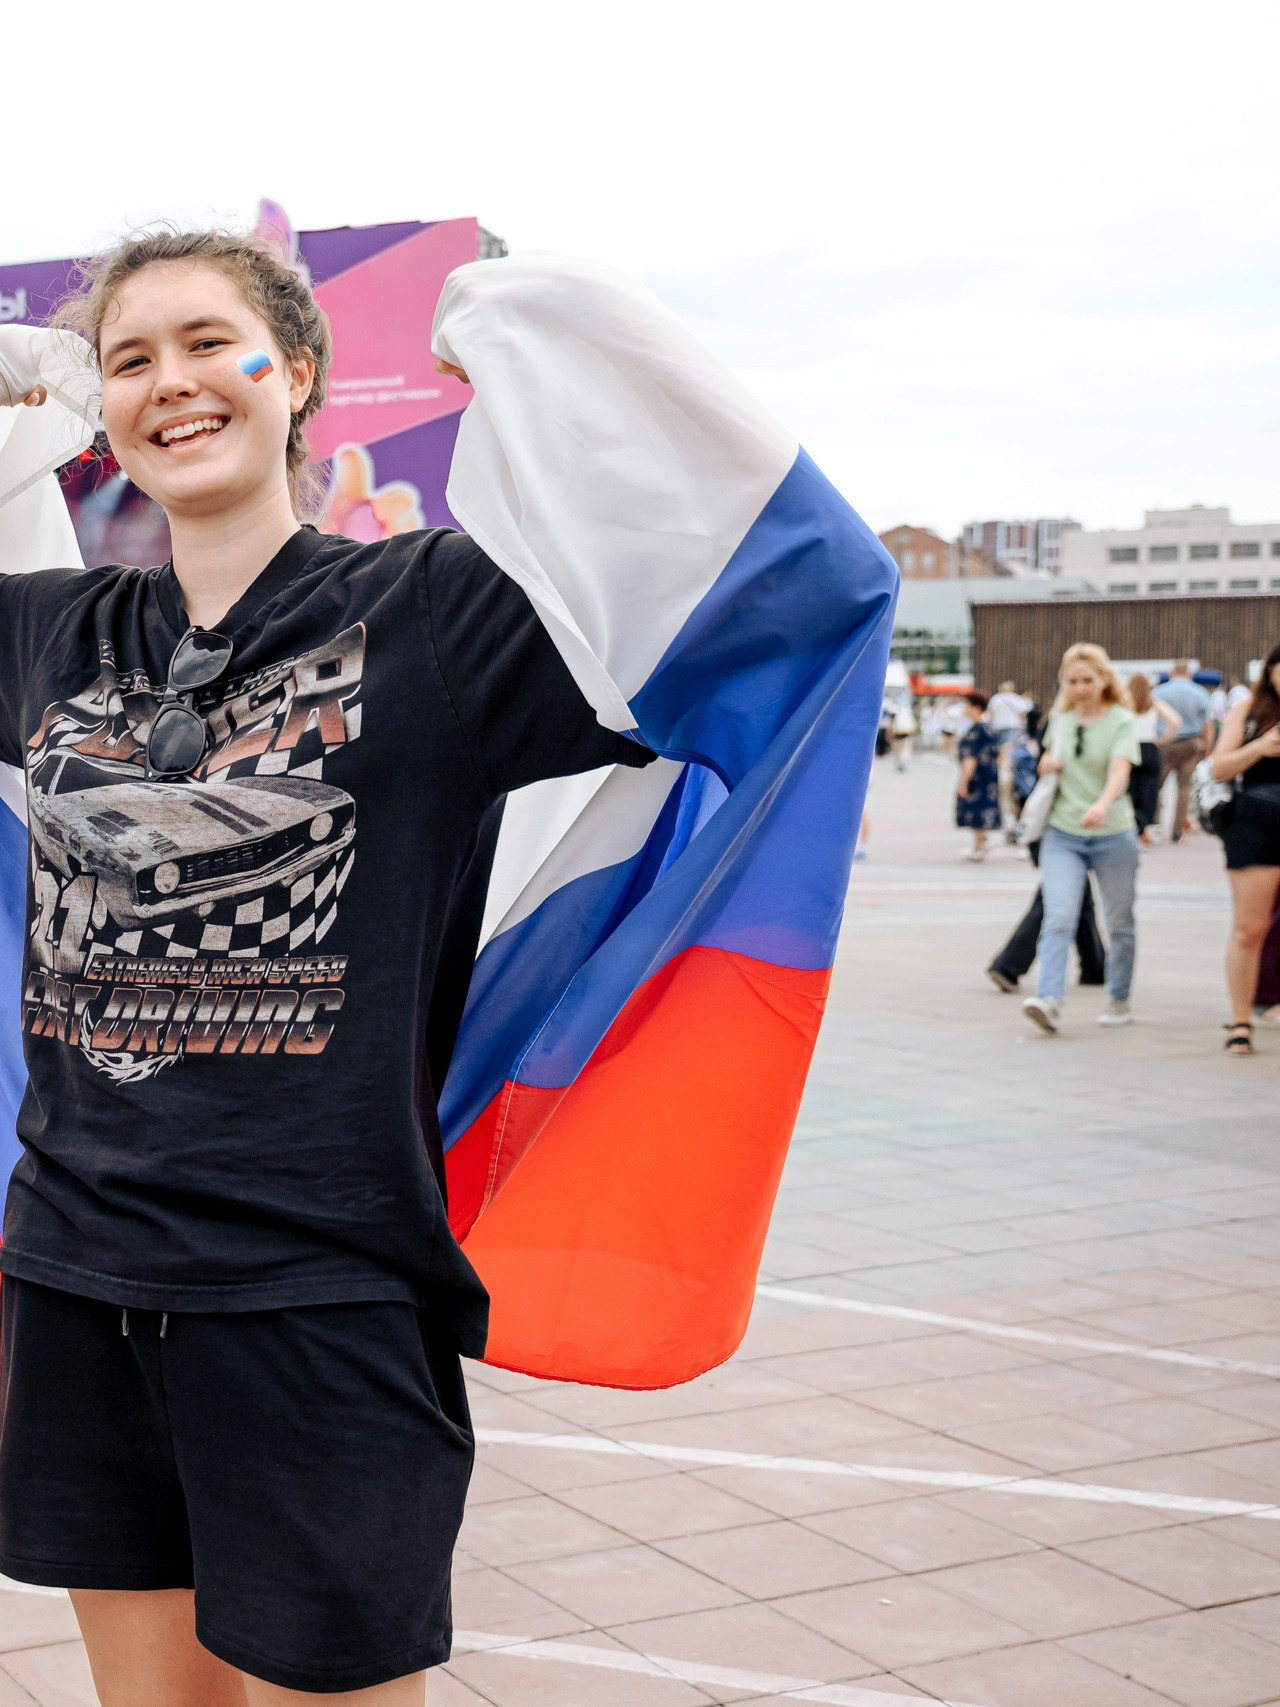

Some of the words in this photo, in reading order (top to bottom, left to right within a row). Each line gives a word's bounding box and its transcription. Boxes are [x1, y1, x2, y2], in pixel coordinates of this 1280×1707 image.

[86, 954, 208, 985] EXTREMELY
[207, 956, 270, 985] HIGH
[267, 954, 350, 985] SPEED
[91, 988, 346, 1055] DRIVING
